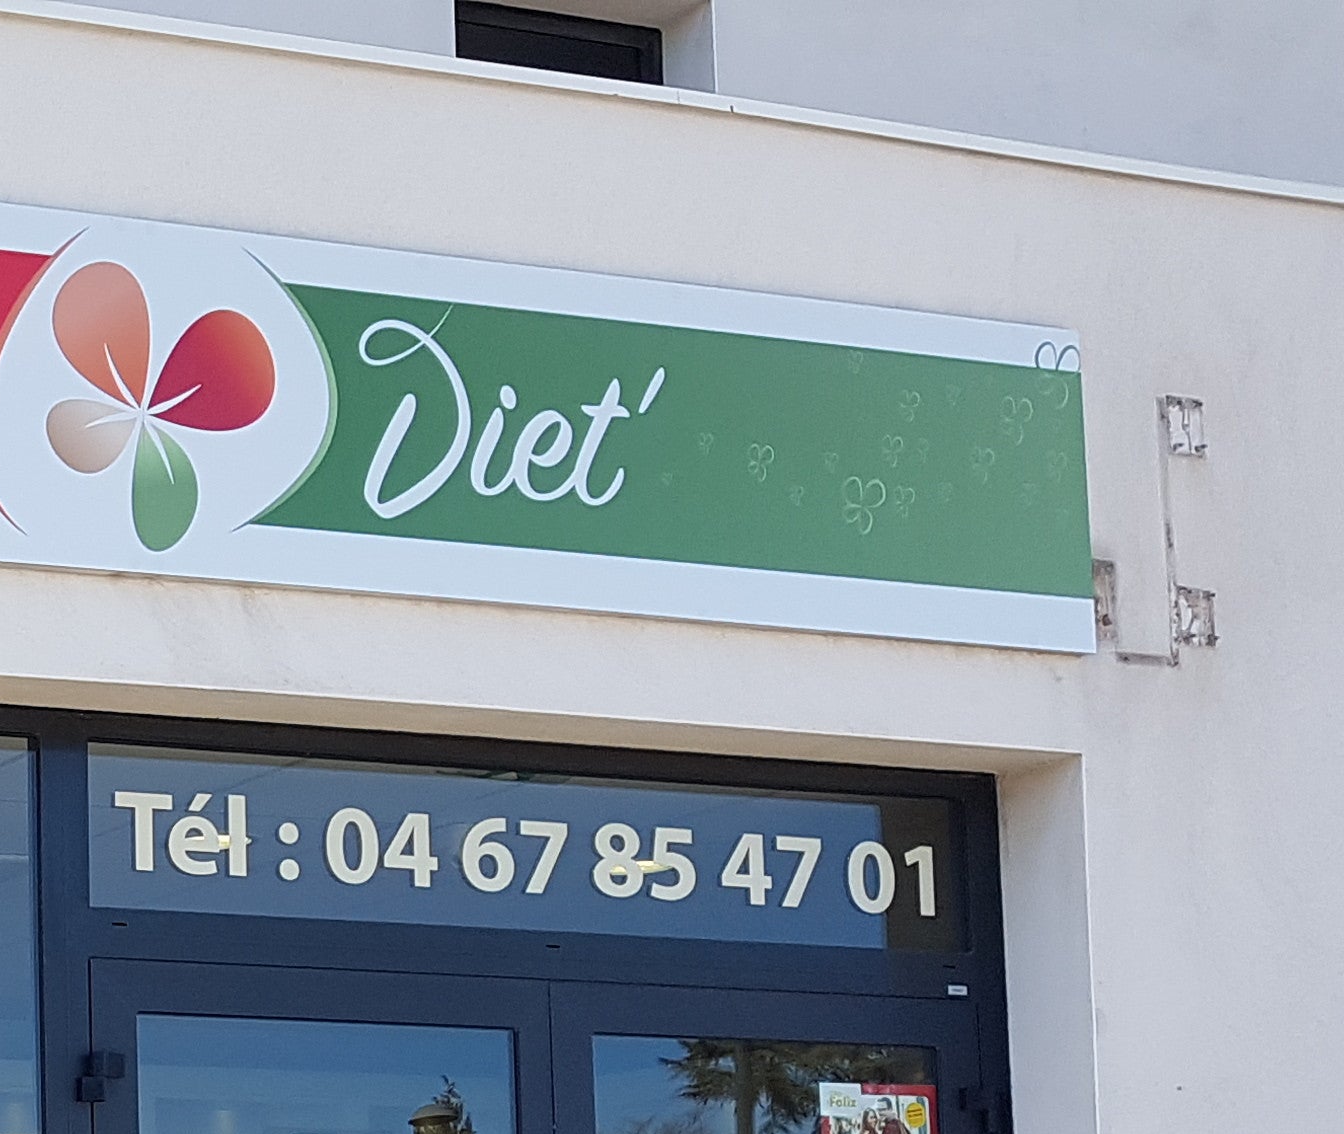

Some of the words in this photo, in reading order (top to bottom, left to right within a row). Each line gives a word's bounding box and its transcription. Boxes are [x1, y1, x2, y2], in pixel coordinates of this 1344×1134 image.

[357, 305, 666, 519] Diet'
[114, 791, 247, 878] Tél
[325, 807, 439, 889] 04
[461, 816, 569, 896] 67
[592, 822, 697, 903] 85
[720, 833, 823, 910] 47
[846, 842, 939, 918] 01
